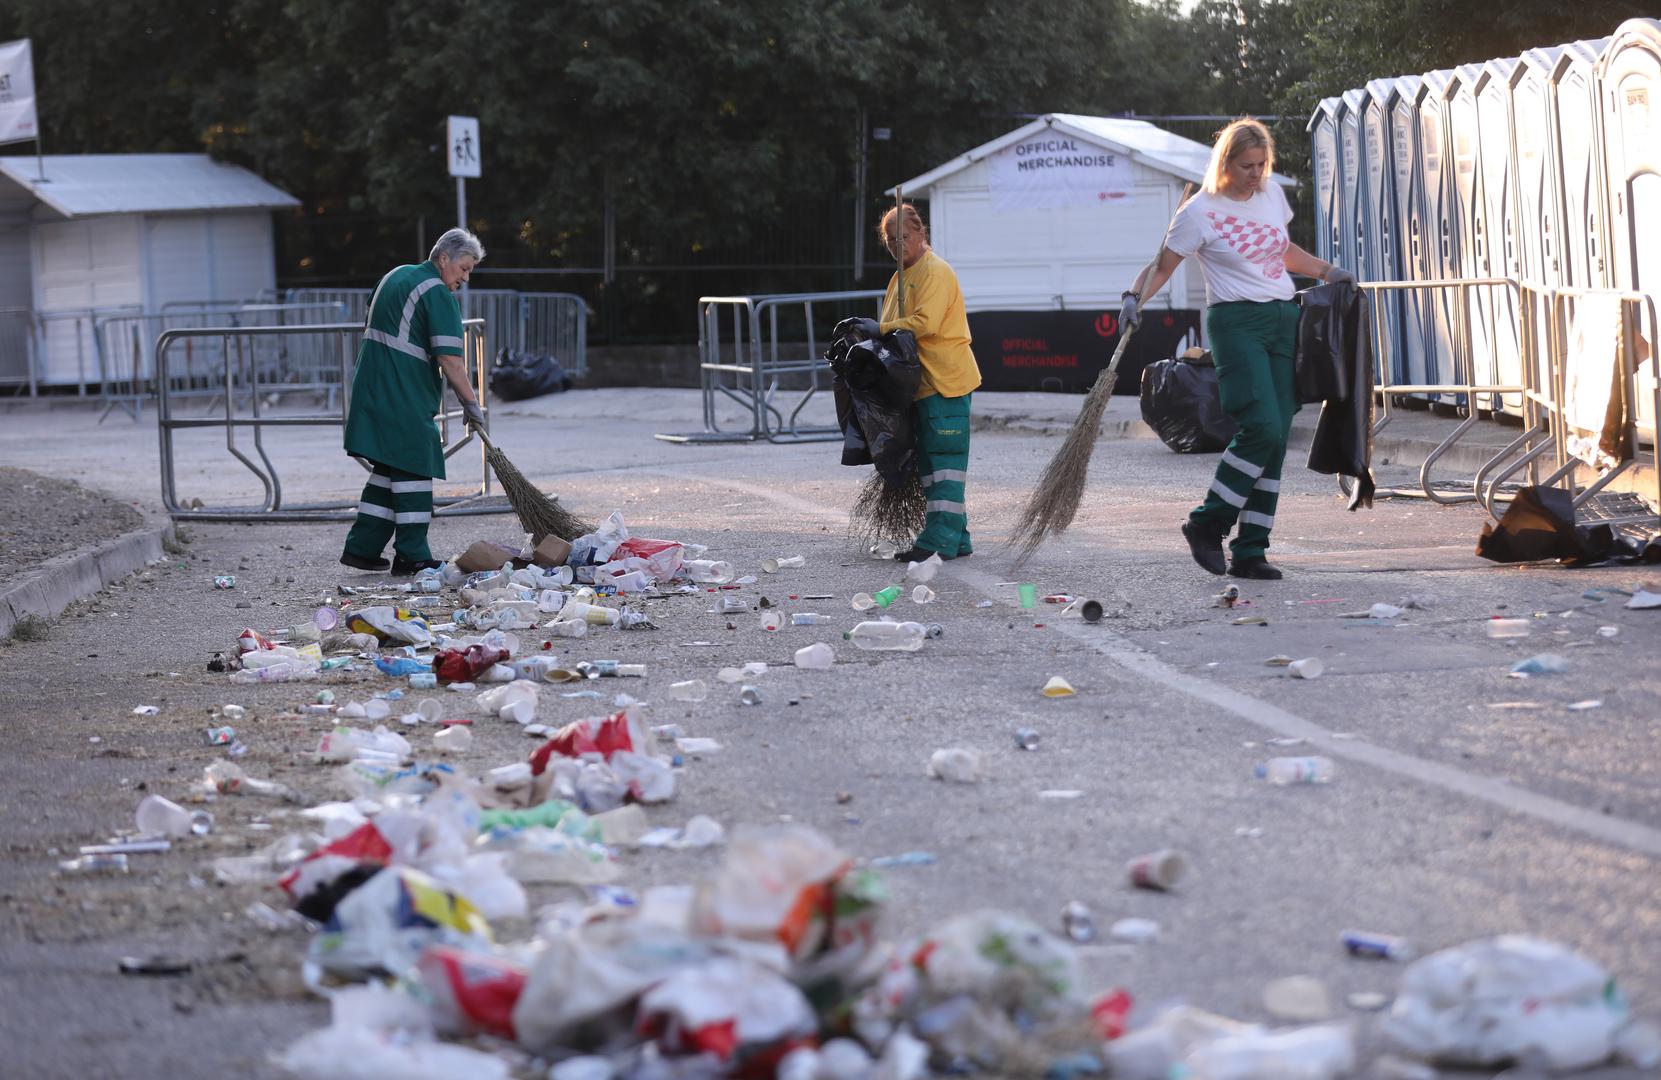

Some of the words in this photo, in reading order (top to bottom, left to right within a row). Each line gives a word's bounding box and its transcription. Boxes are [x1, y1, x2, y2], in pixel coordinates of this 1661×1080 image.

[1015, 140, 1078, 156] OFFICIAL
[1017, 155, 1115, 172] MERCHANDISE
[1002, 339, 1048, 352] OFFICIAL
[1002, 355, 1079, 368] MERCHANDISE
